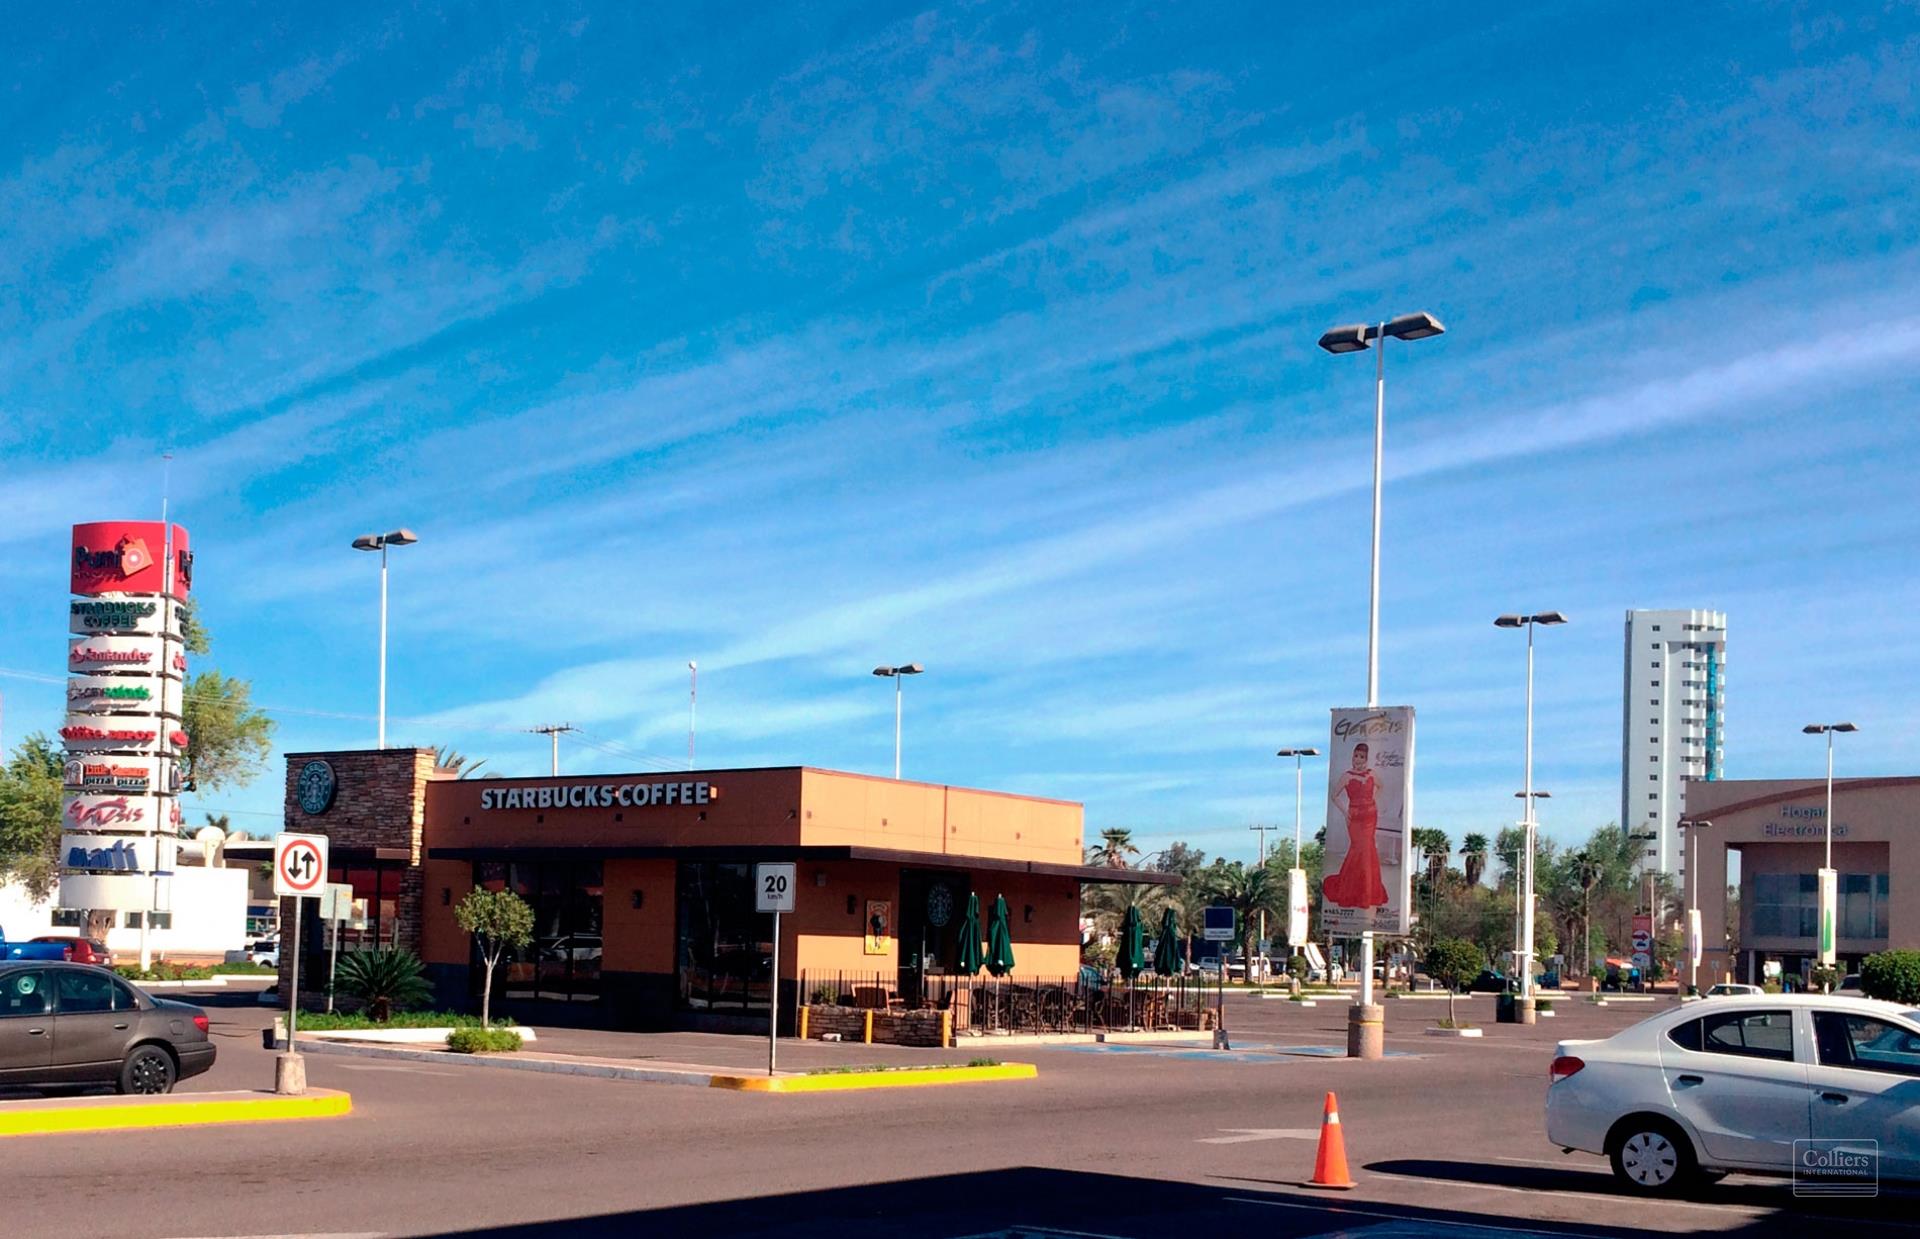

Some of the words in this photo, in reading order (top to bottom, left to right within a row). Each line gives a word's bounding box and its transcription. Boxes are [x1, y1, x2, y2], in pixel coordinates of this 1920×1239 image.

[71, 601, 156, 616] STARBUCKS
[86, 648, 152, 663] Santander
[480, 784, 613, 810] STARBUCKS
[618, 782, 709, 807] COFFEE
[1782, 805, 1826, 821] Hogar
[765, 875, 787, 893] 20
